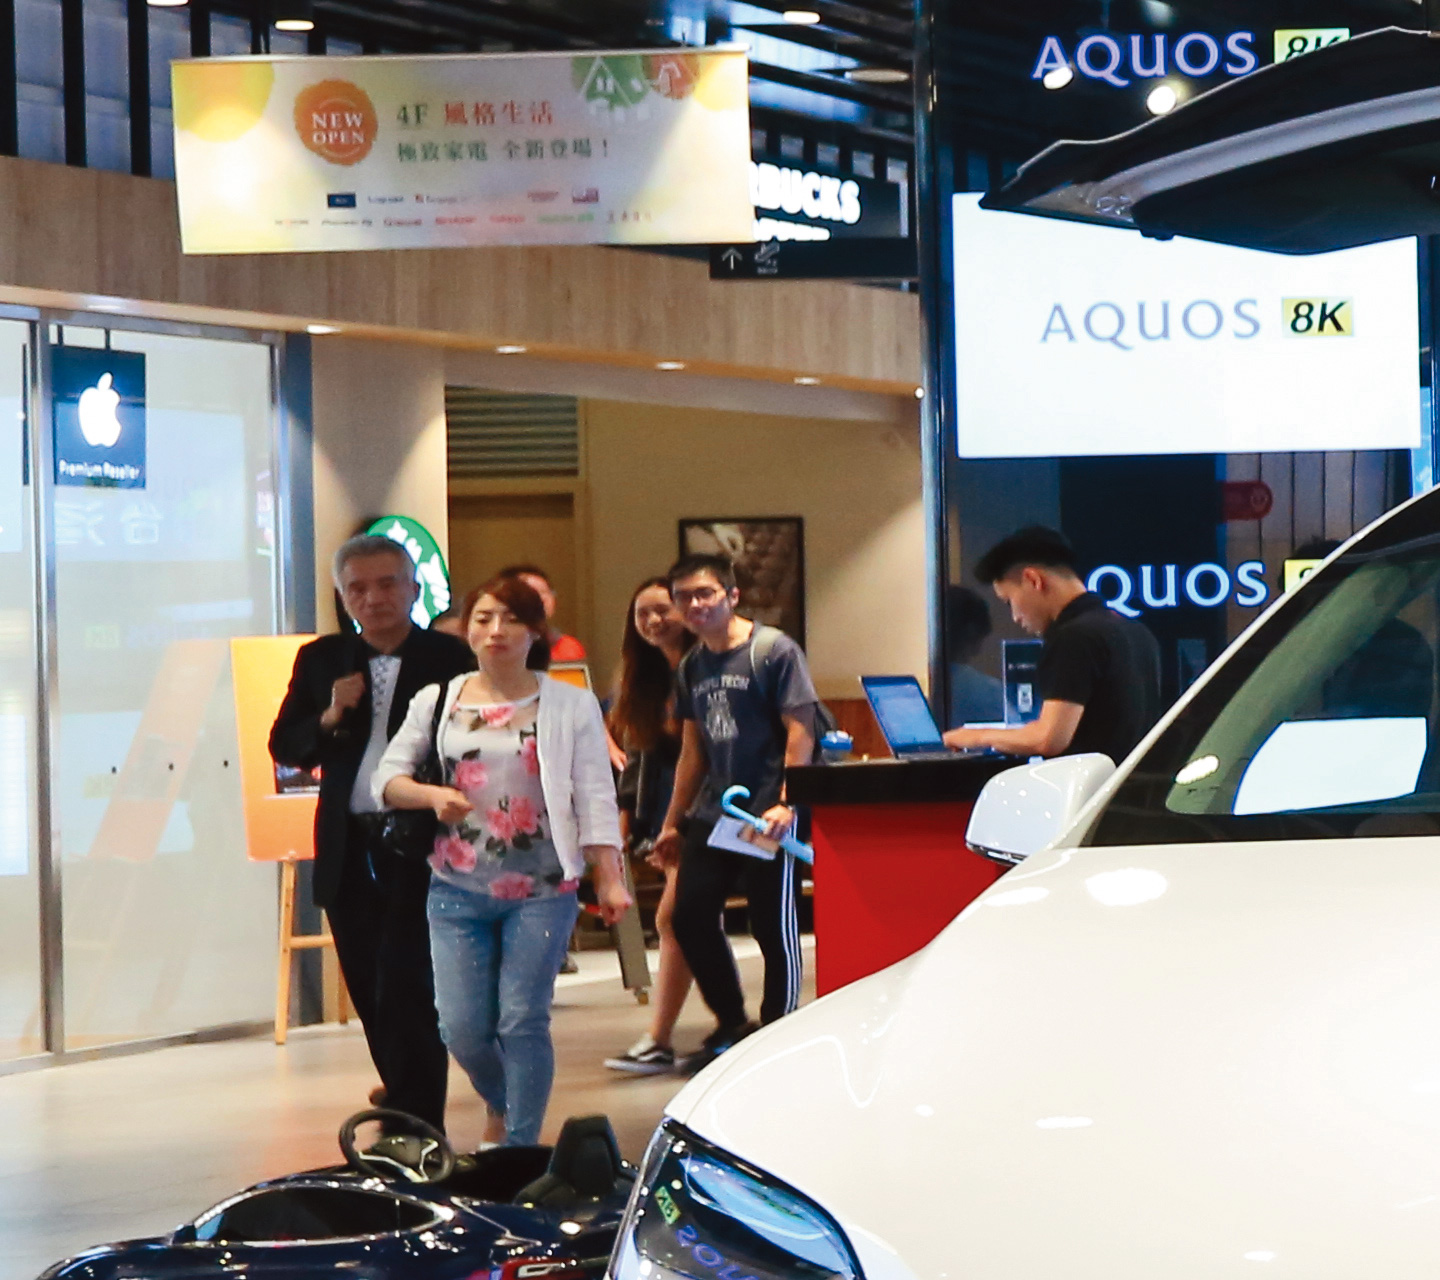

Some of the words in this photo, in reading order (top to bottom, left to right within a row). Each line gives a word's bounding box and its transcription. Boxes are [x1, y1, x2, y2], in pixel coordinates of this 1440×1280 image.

[1032, 31, 1257, 87] AQUOS
[312, 113, 363, 129] NEW
[312, 130, 365, 145] OPEN
[1041, 299, 1260, 351] AQUOS
[1290, 301, 1347, 333] 8K
[1087, 561, 1269, 617] QUOS
